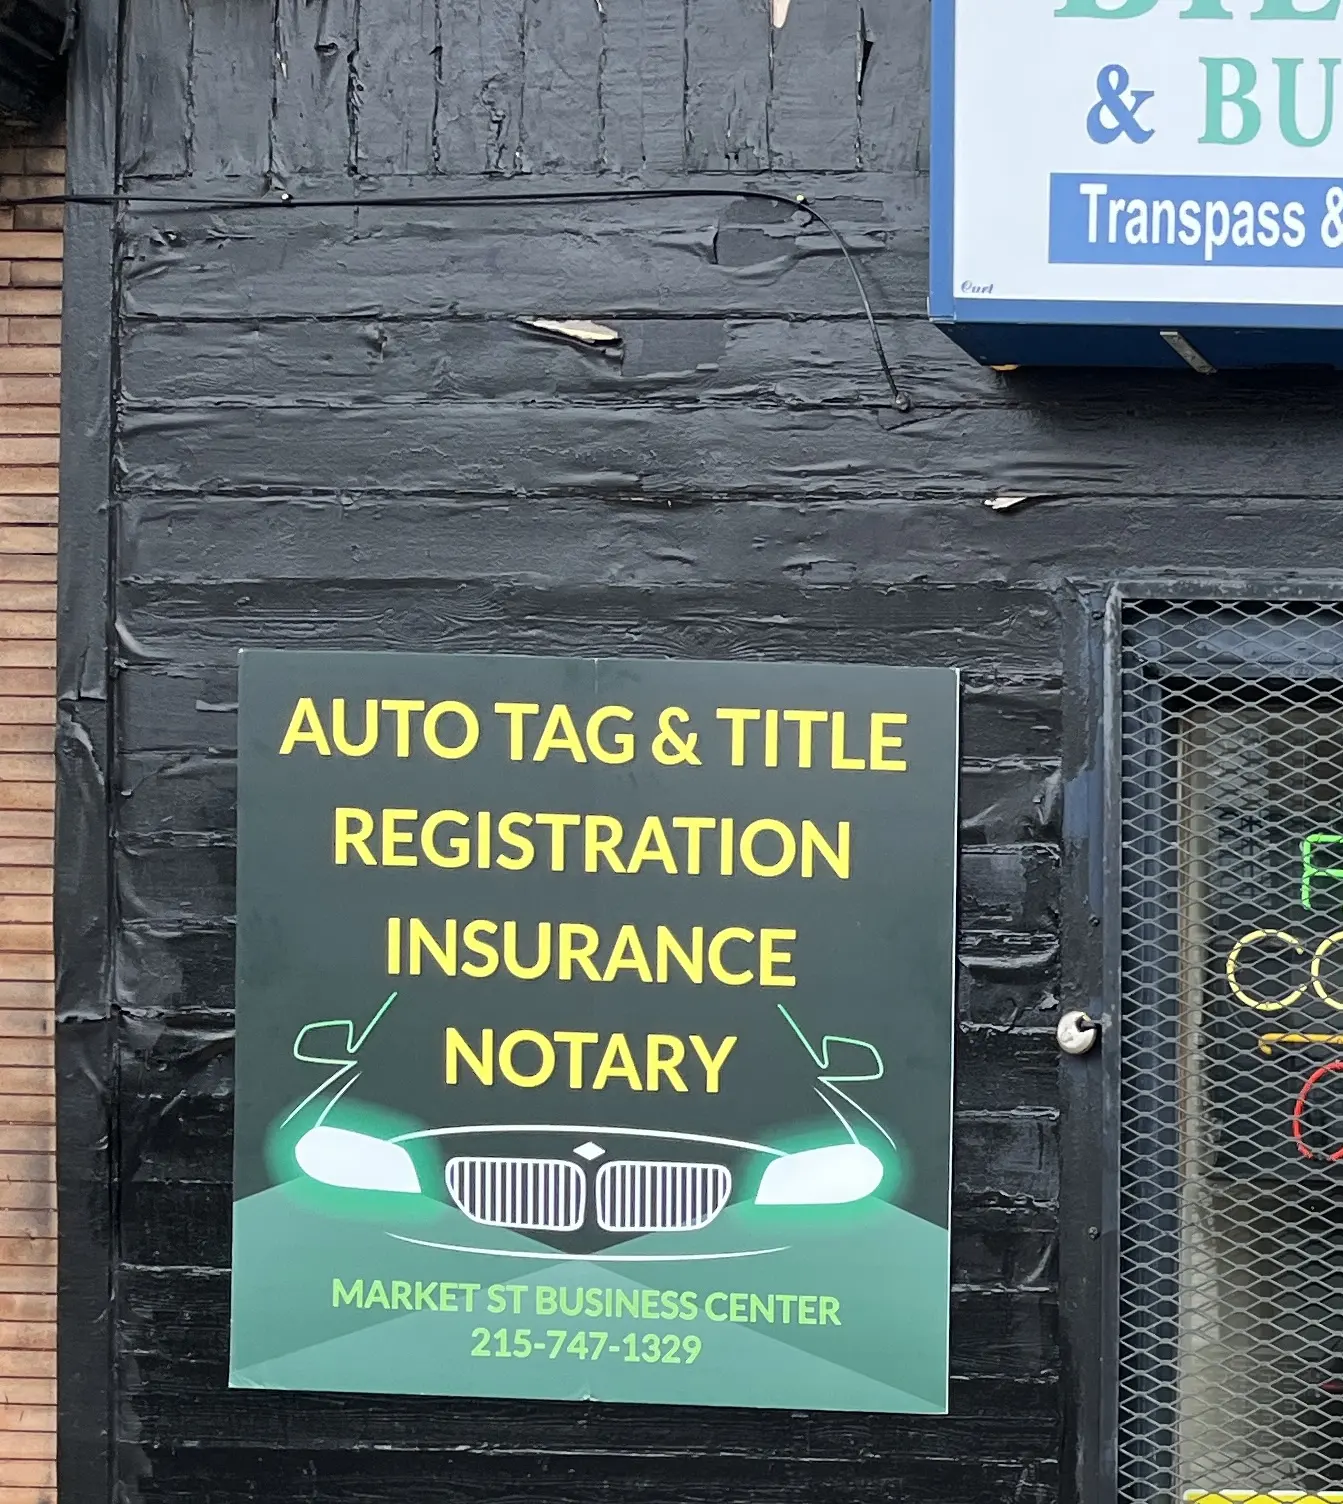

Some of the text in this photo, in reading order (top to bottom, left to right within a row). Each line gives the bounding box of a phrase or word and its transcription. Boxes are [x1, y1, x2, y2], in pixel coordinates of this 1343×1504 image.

[1086, 63, 1155, 145] &
[1080, 183, 1305, 261] Transpass
[279, 697, 909, 771] AUTO TAG & TITLE
[334, 807, 850, 879] REGISTRATION
[386, 917, 797, 987] INSURANCE
[444, 1027, 738, 1093] NOTARY
[331, 1278, 842, 1326] MARKET ST BUSINESS CENTER
[470, 1328, 702, 1364] 215-747-1329
